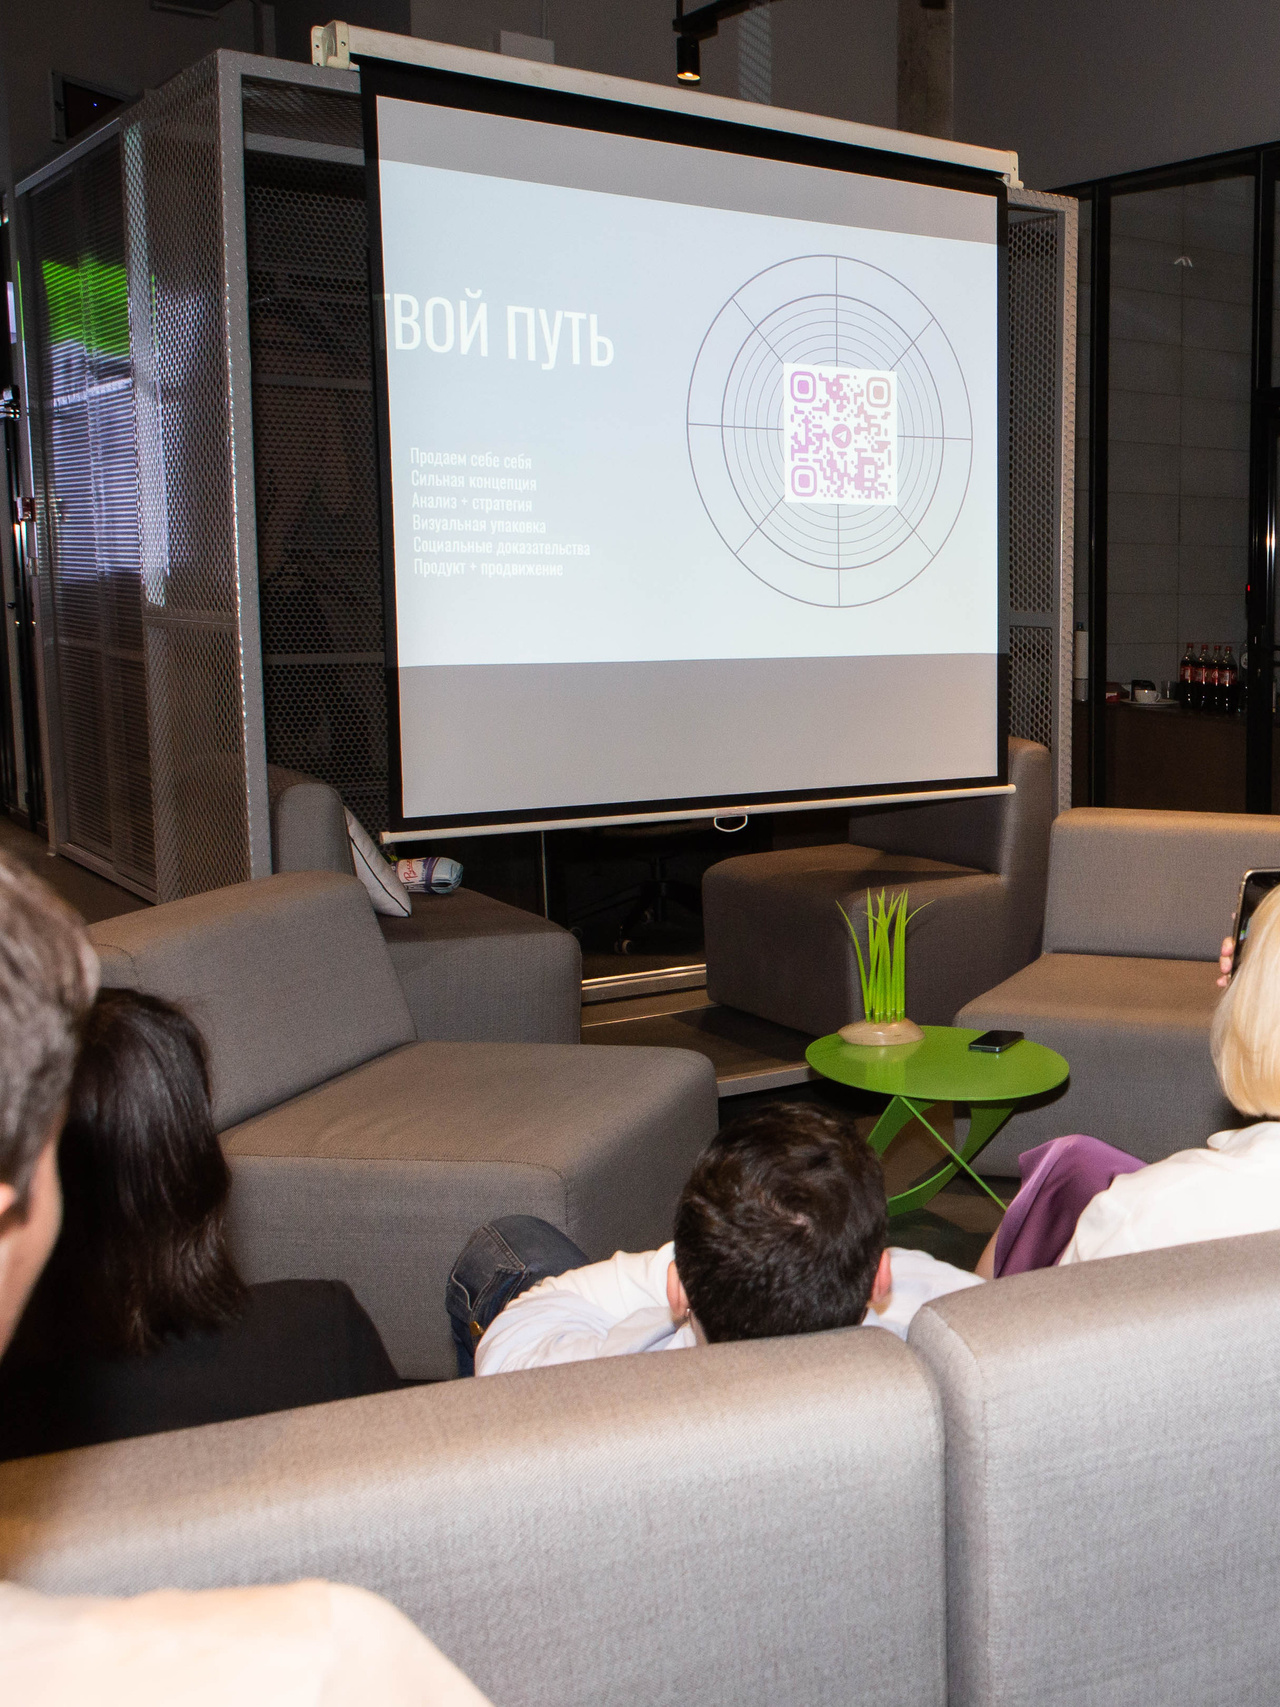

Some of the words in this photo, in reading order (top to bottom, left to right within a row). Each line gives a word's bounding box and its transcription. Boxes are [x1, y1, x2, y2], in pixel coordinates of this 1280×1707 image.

[506, 304, 615, 371] ПУТЬ
[410, 447, 467, 467] Продаем
[470, 451, 500, 468] себе
[503, 453, 532, 470] себя
[411, 469, 465, 487] Сильная
[469, 474, 537, 493] концепция
[412, 491, 457, 509] Анализ
[472, 496, 533, 513] стратегия
[413, 514, 487, 533] Визуальная
[490, 520, 547, 535] упаковка
[413, 536, 493, 555] Социальные
[496, 541, 591, 557] доказательства
[414, 558, 466, 578] Продукт
[481, 562, 564, 578] продвижение
